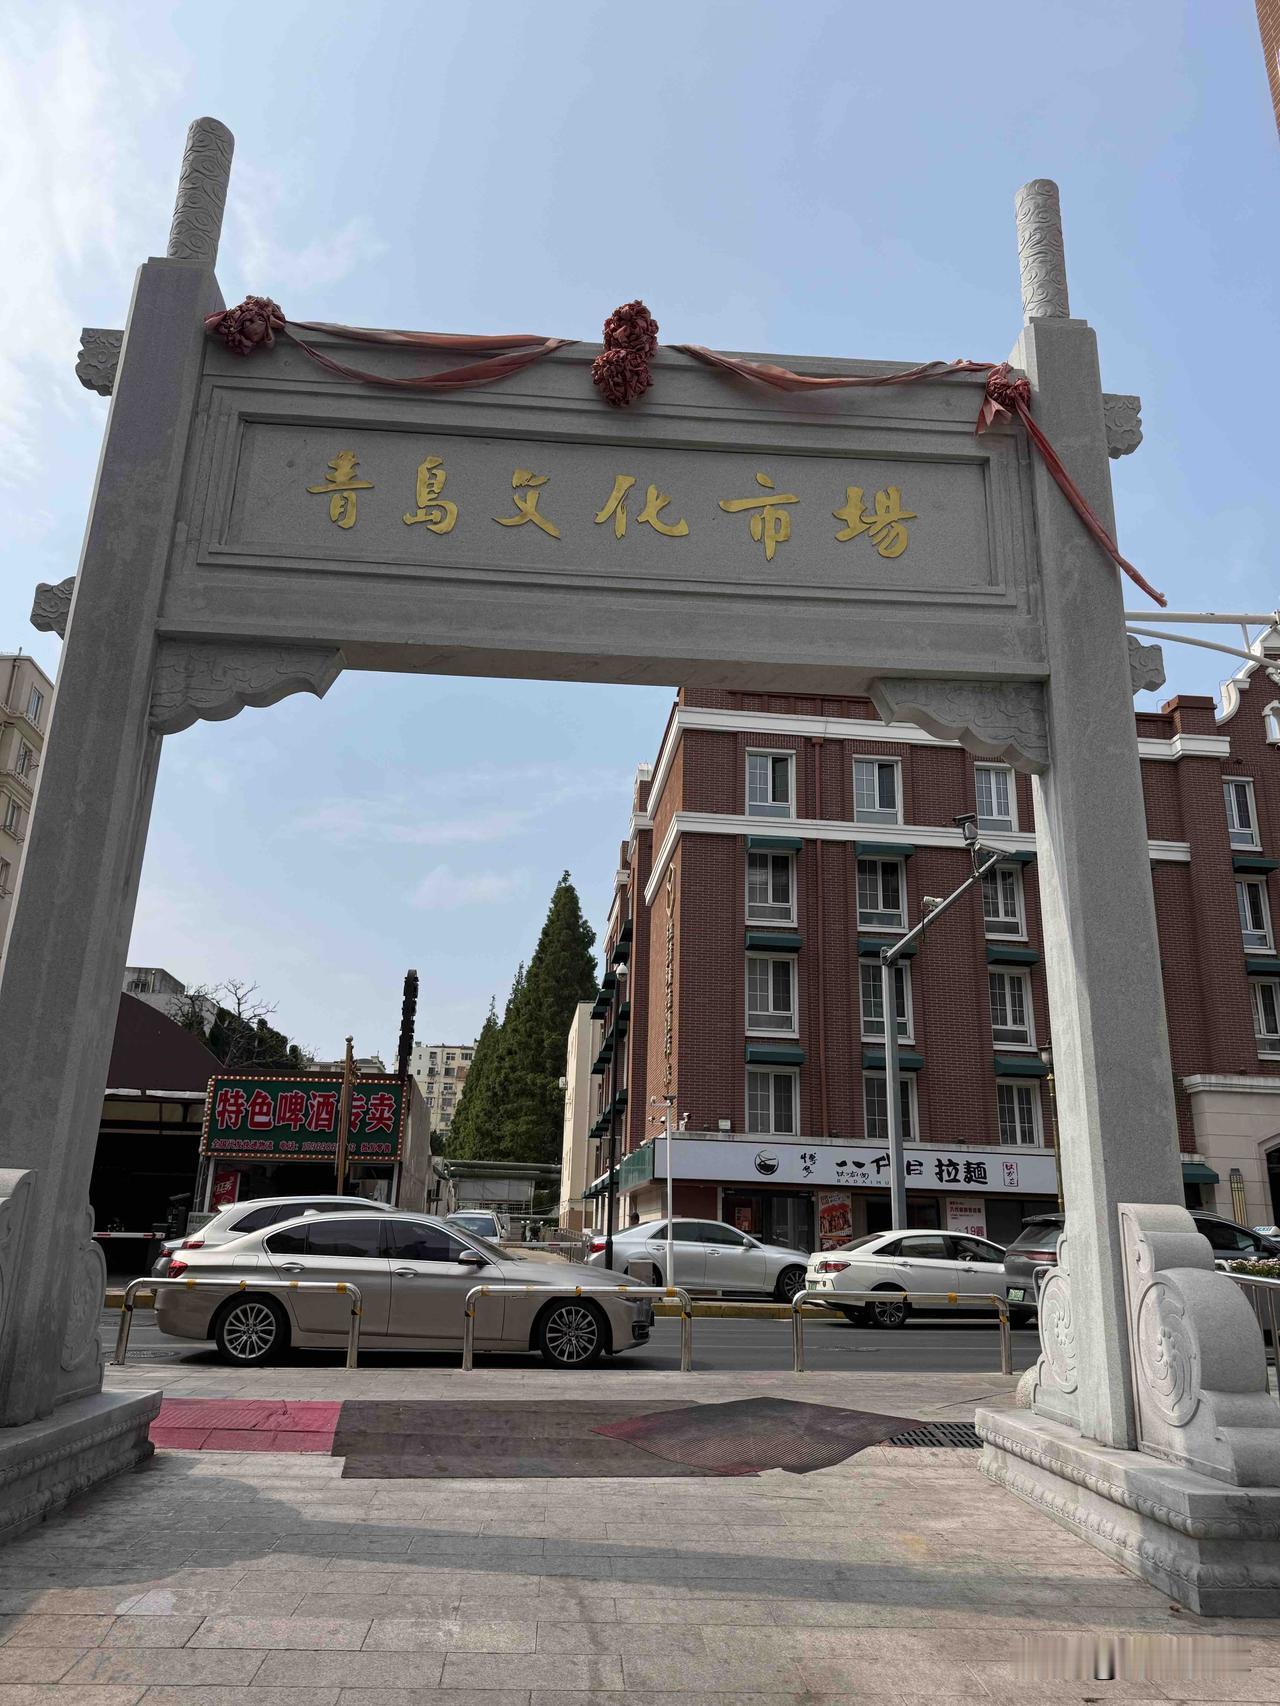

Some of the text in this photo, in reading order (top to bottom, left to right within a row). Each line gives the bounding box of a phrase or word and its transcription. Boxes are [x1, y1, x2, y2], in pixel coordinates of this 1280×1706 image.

[306, 450, 918, 561] 青島文化市場
